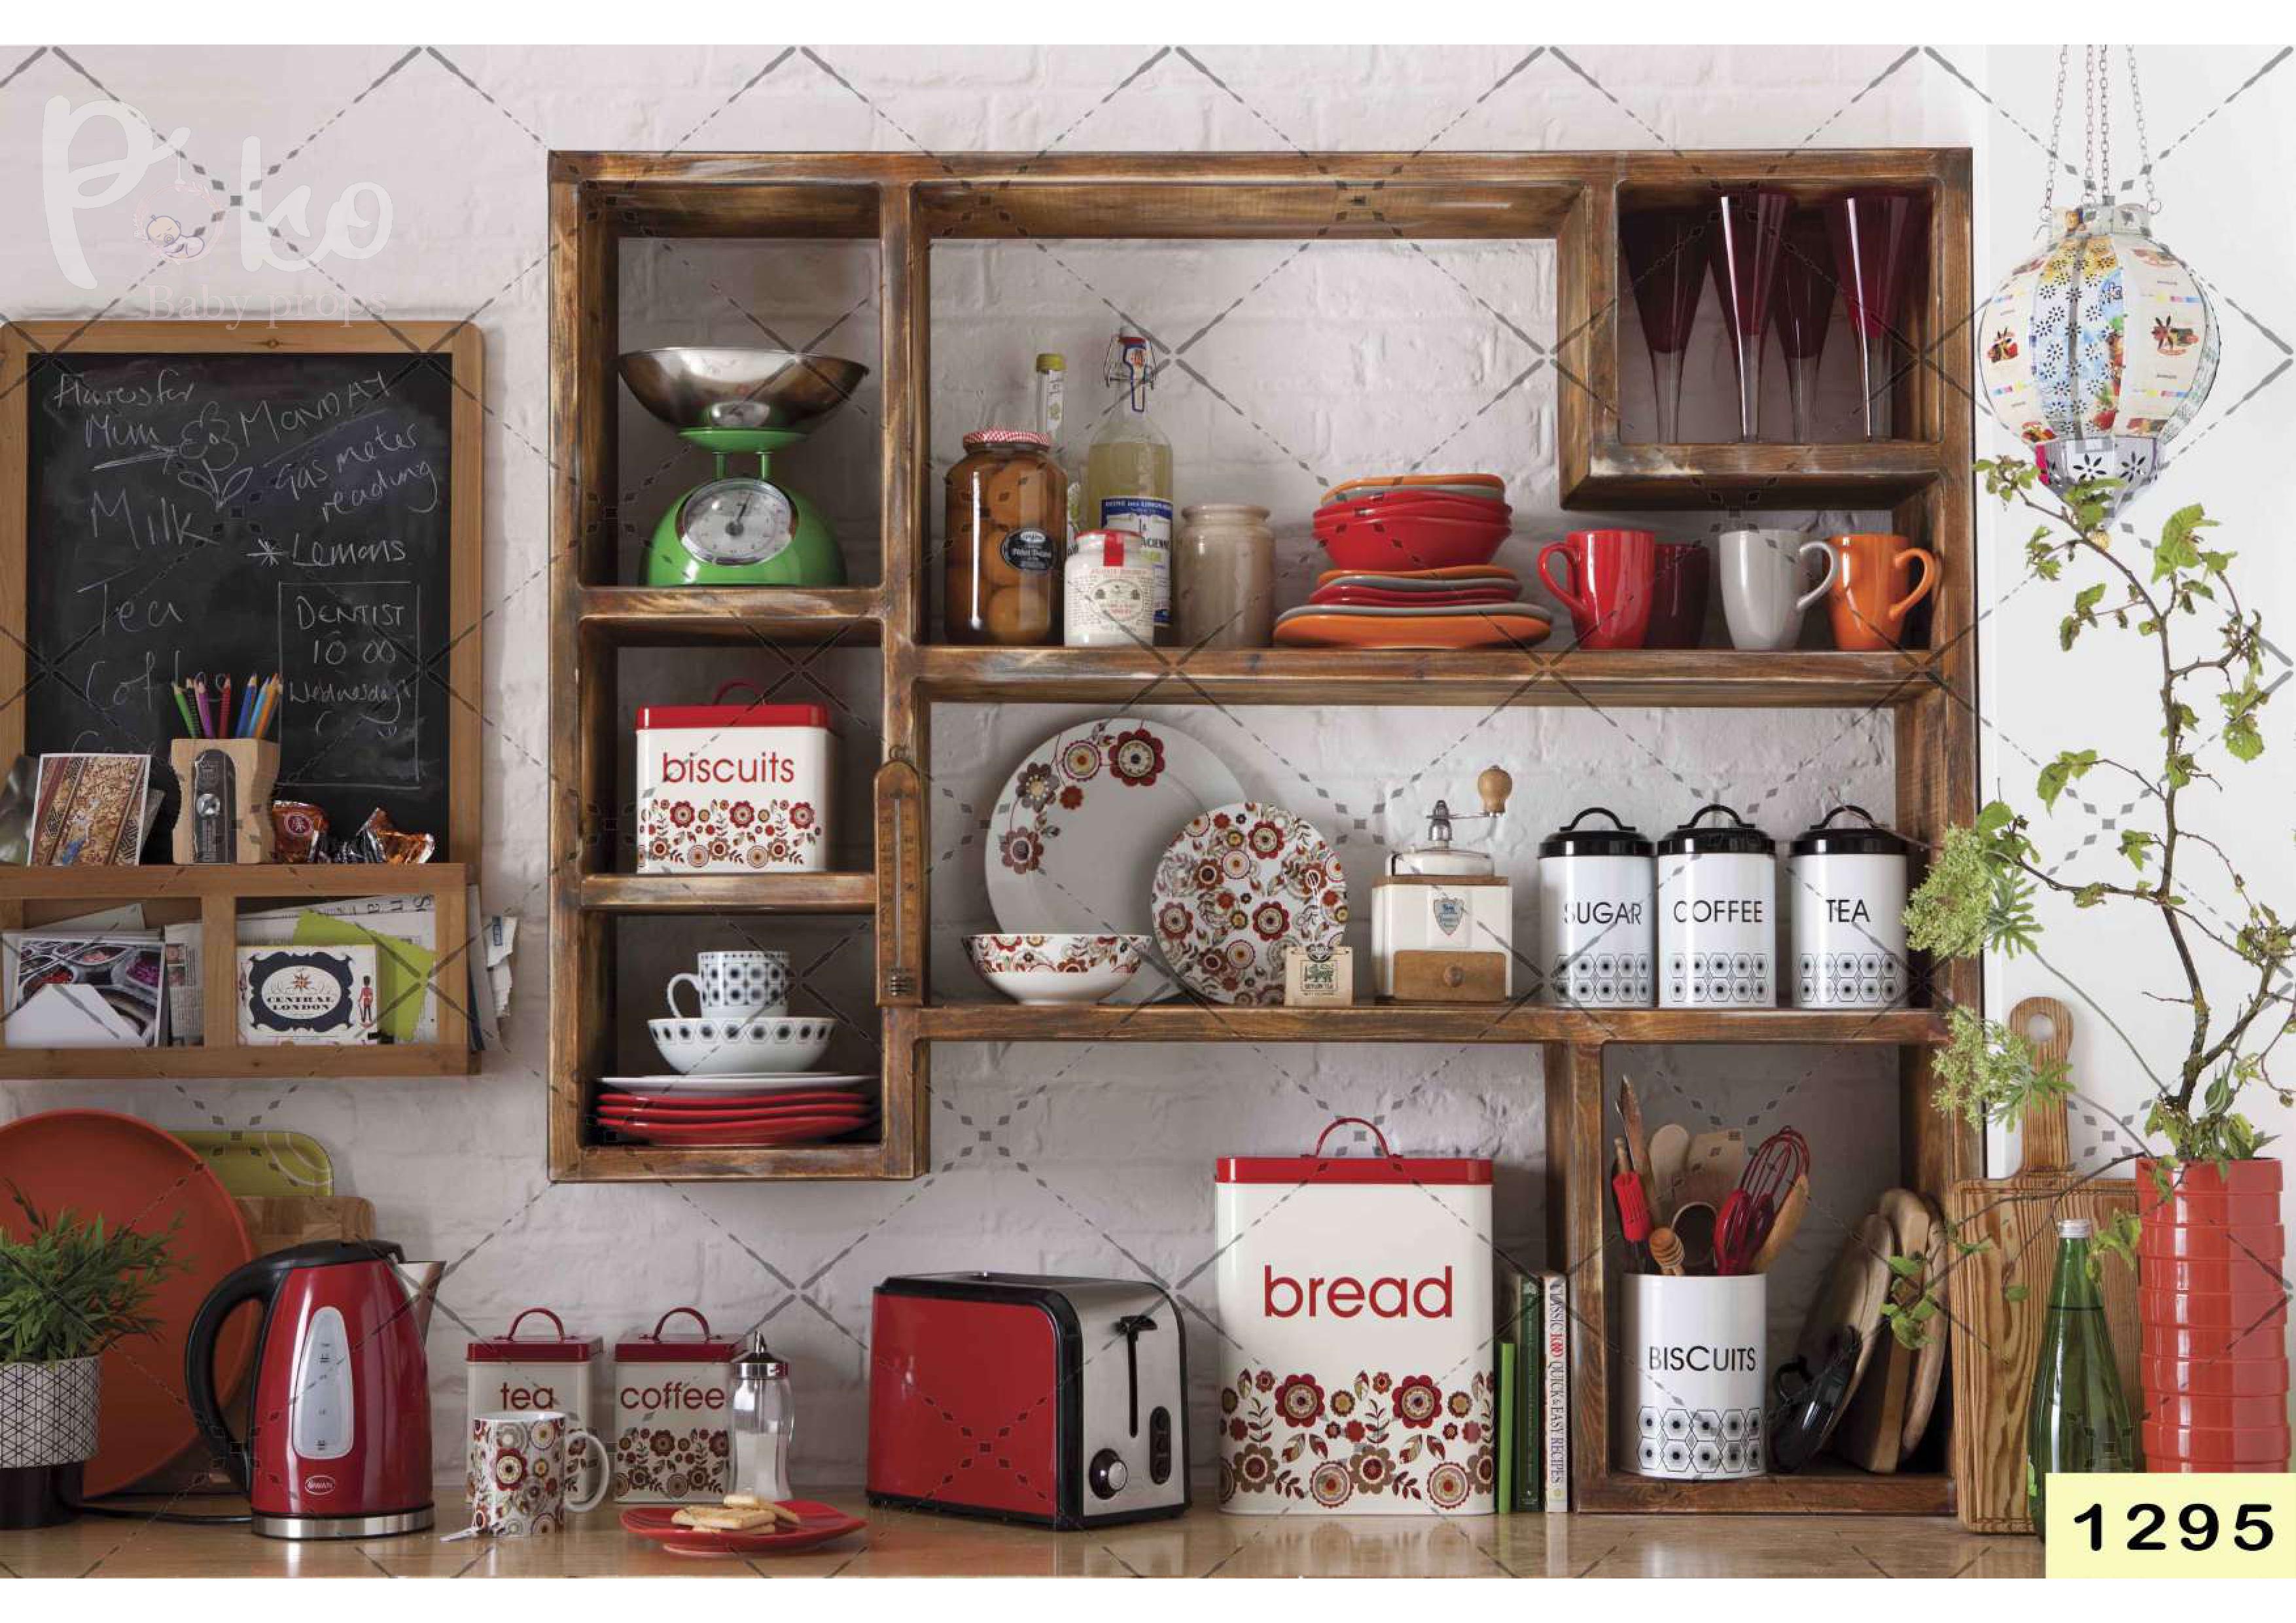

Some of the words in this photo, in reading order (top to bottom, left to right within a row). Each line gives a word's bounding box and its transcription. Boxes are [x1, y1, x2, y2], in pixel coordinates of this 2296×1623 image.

[85, 413, 159, 448] Mum
[90, 486, 220, 550] Milk
[75, 567, 184, 637] Tea
[662, 751, 795, 783] biscuits
[1564, 901, 1642, 925] SUGAR
[1673, 900, 1763, 924] COFFEE
[1826, 899, 1871, 923] TEA
[1264, 1264, 1453, 1318] bread
[1648, 1346, 1756, 1372] BISCUITS
[1548, 1361, 1564, 1398] QUICK
[500, 1382, 554, 1410] tea
[620, 1381, 724, 1410] coffee
[1550, 1406, 1564, 1433] EASY
[1550, 1436, 1564, 1484] RECIPES
